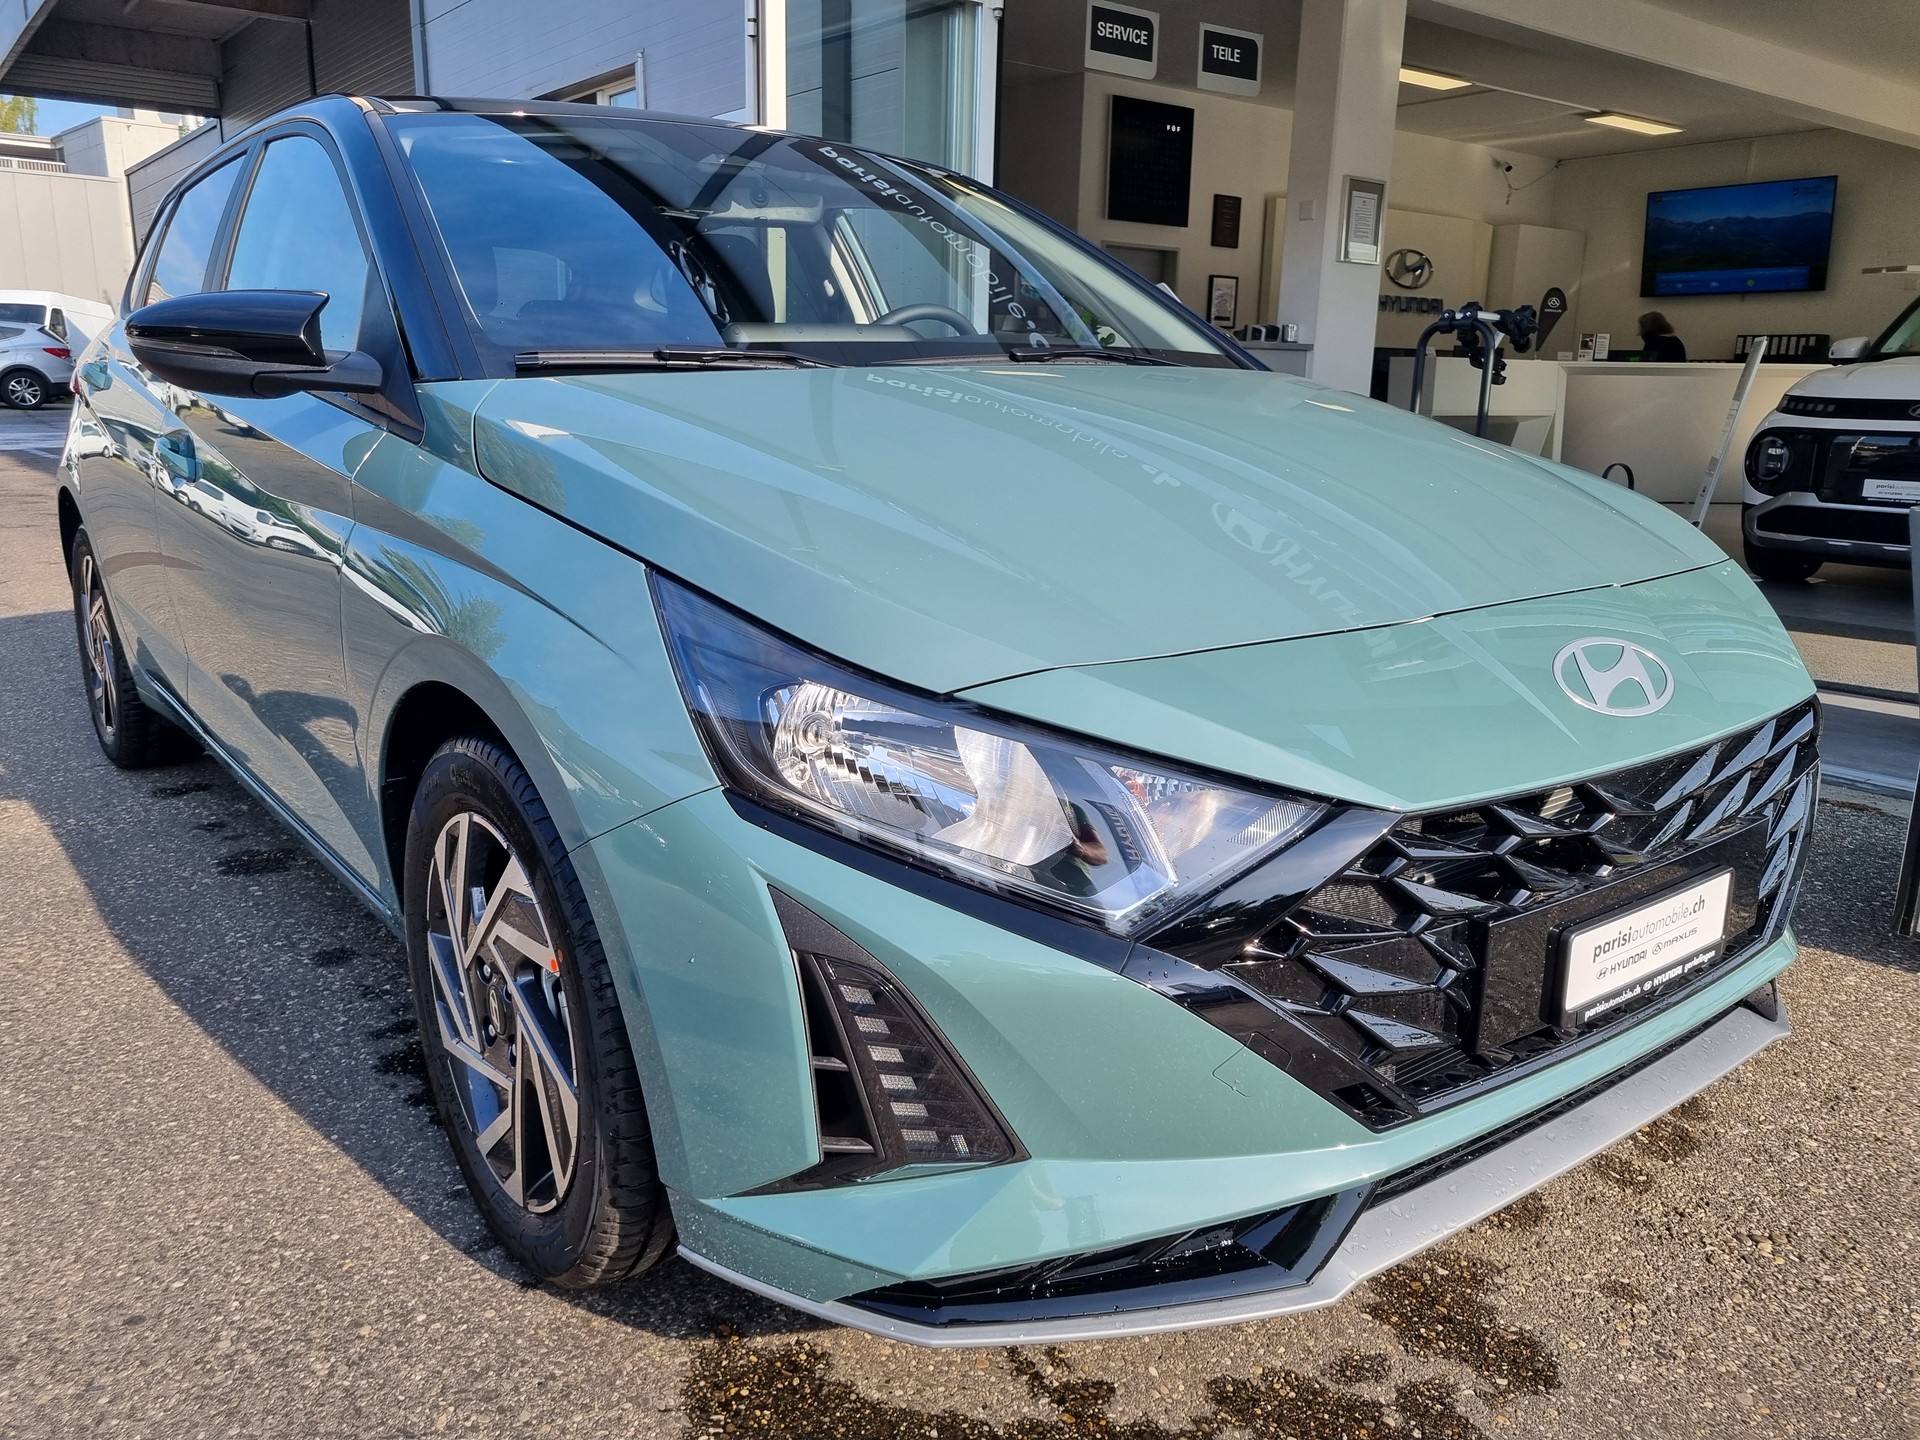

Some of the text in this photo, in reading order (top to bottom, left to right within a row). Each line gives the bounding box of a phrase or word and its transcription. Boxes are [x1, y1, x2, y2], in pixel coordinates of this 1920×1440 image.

[1097, 21, 1149, 46] SERVICE
[1211, 44, 1241, 63] TEILE
[1379, 294, 1444, 316] HYUNDAI
[1592, 894, 1706, 964] parisiautomobile.ch
[1609, 948, 1648, 977] HYUNDAI
[1584, 983, 1642, 1022] parisiautomobile.ch
[1653, 964, 1683, 987] HYUNDAI
